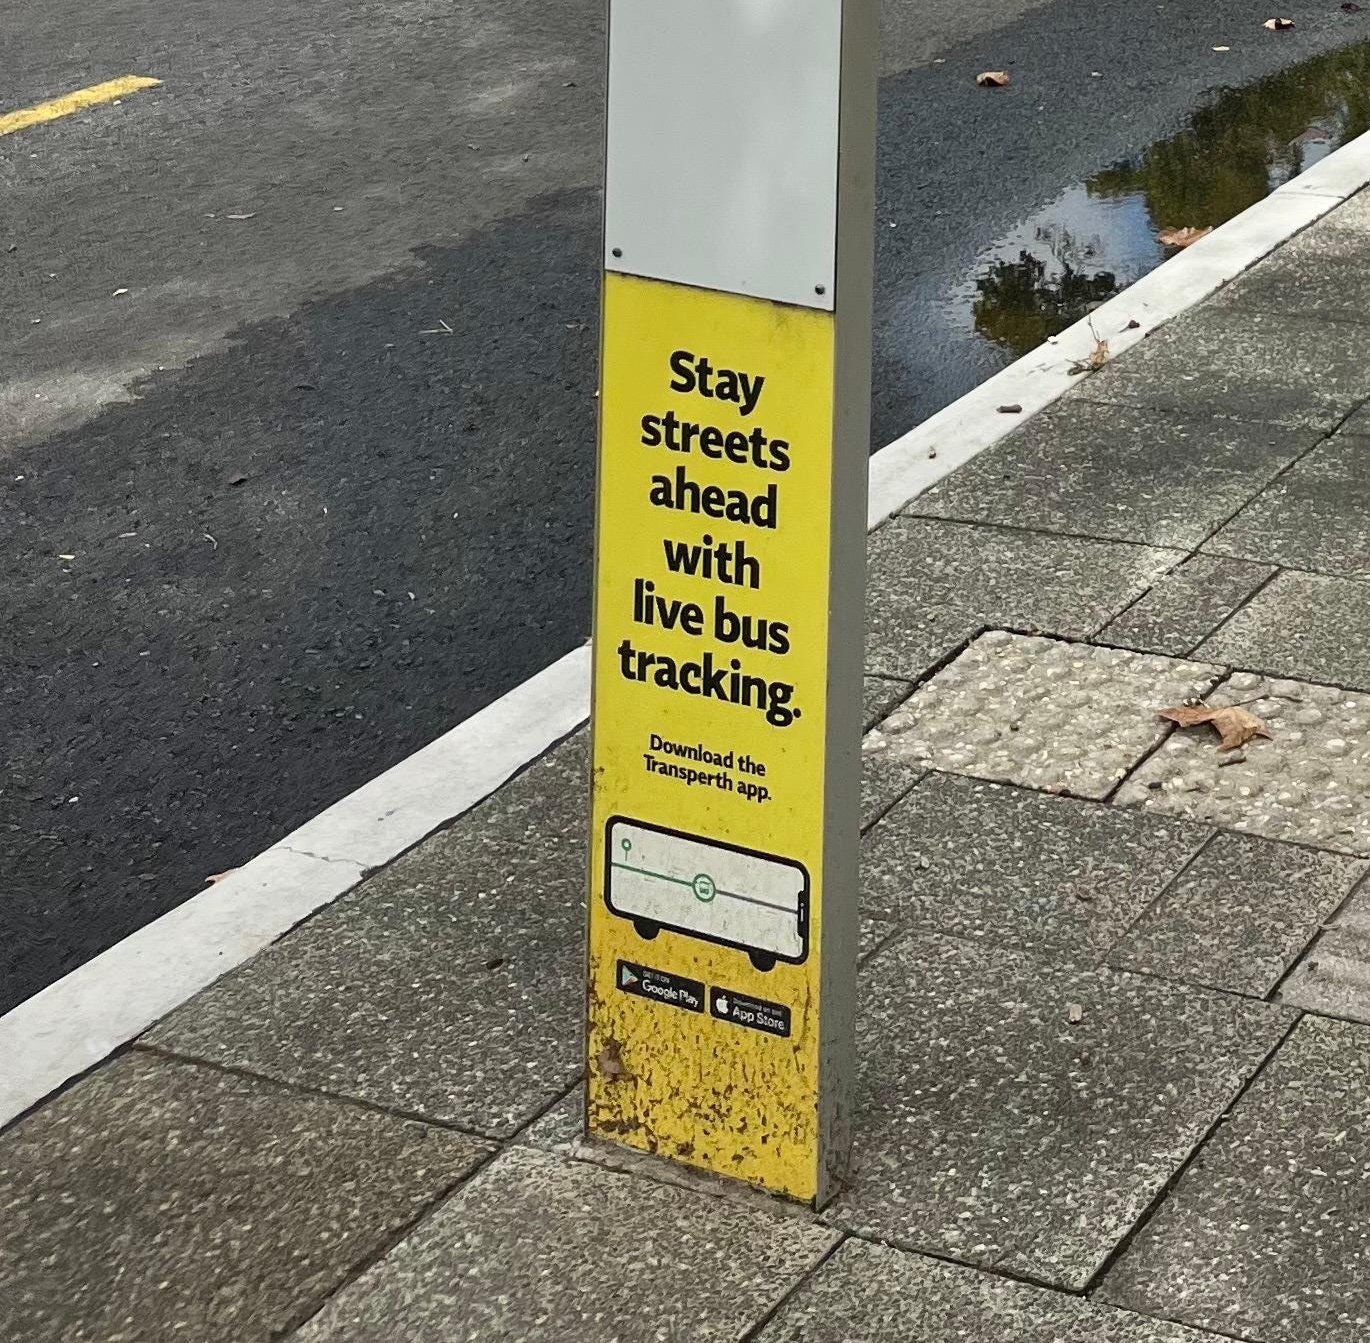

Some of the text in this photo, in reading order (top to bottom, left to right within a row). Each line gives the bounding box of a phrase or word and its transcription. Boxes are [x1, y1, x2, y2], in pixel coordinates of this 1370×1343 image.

[669, 350, 765, 416] Stay
[641, 411, 790, 472] streets
[649, 465, 777, 529] ahead
[663, 534, 760, 589] with
[633, 578, 790, 655] live bus
[617, 640, 801, 727] tracking.
[643, 753, 771, 803] Transperth app.
[649, 733, 765, 776] Download the
[642, 980, 698, 1007] Google Play
[733, 1006, 785, 1031] App Store
